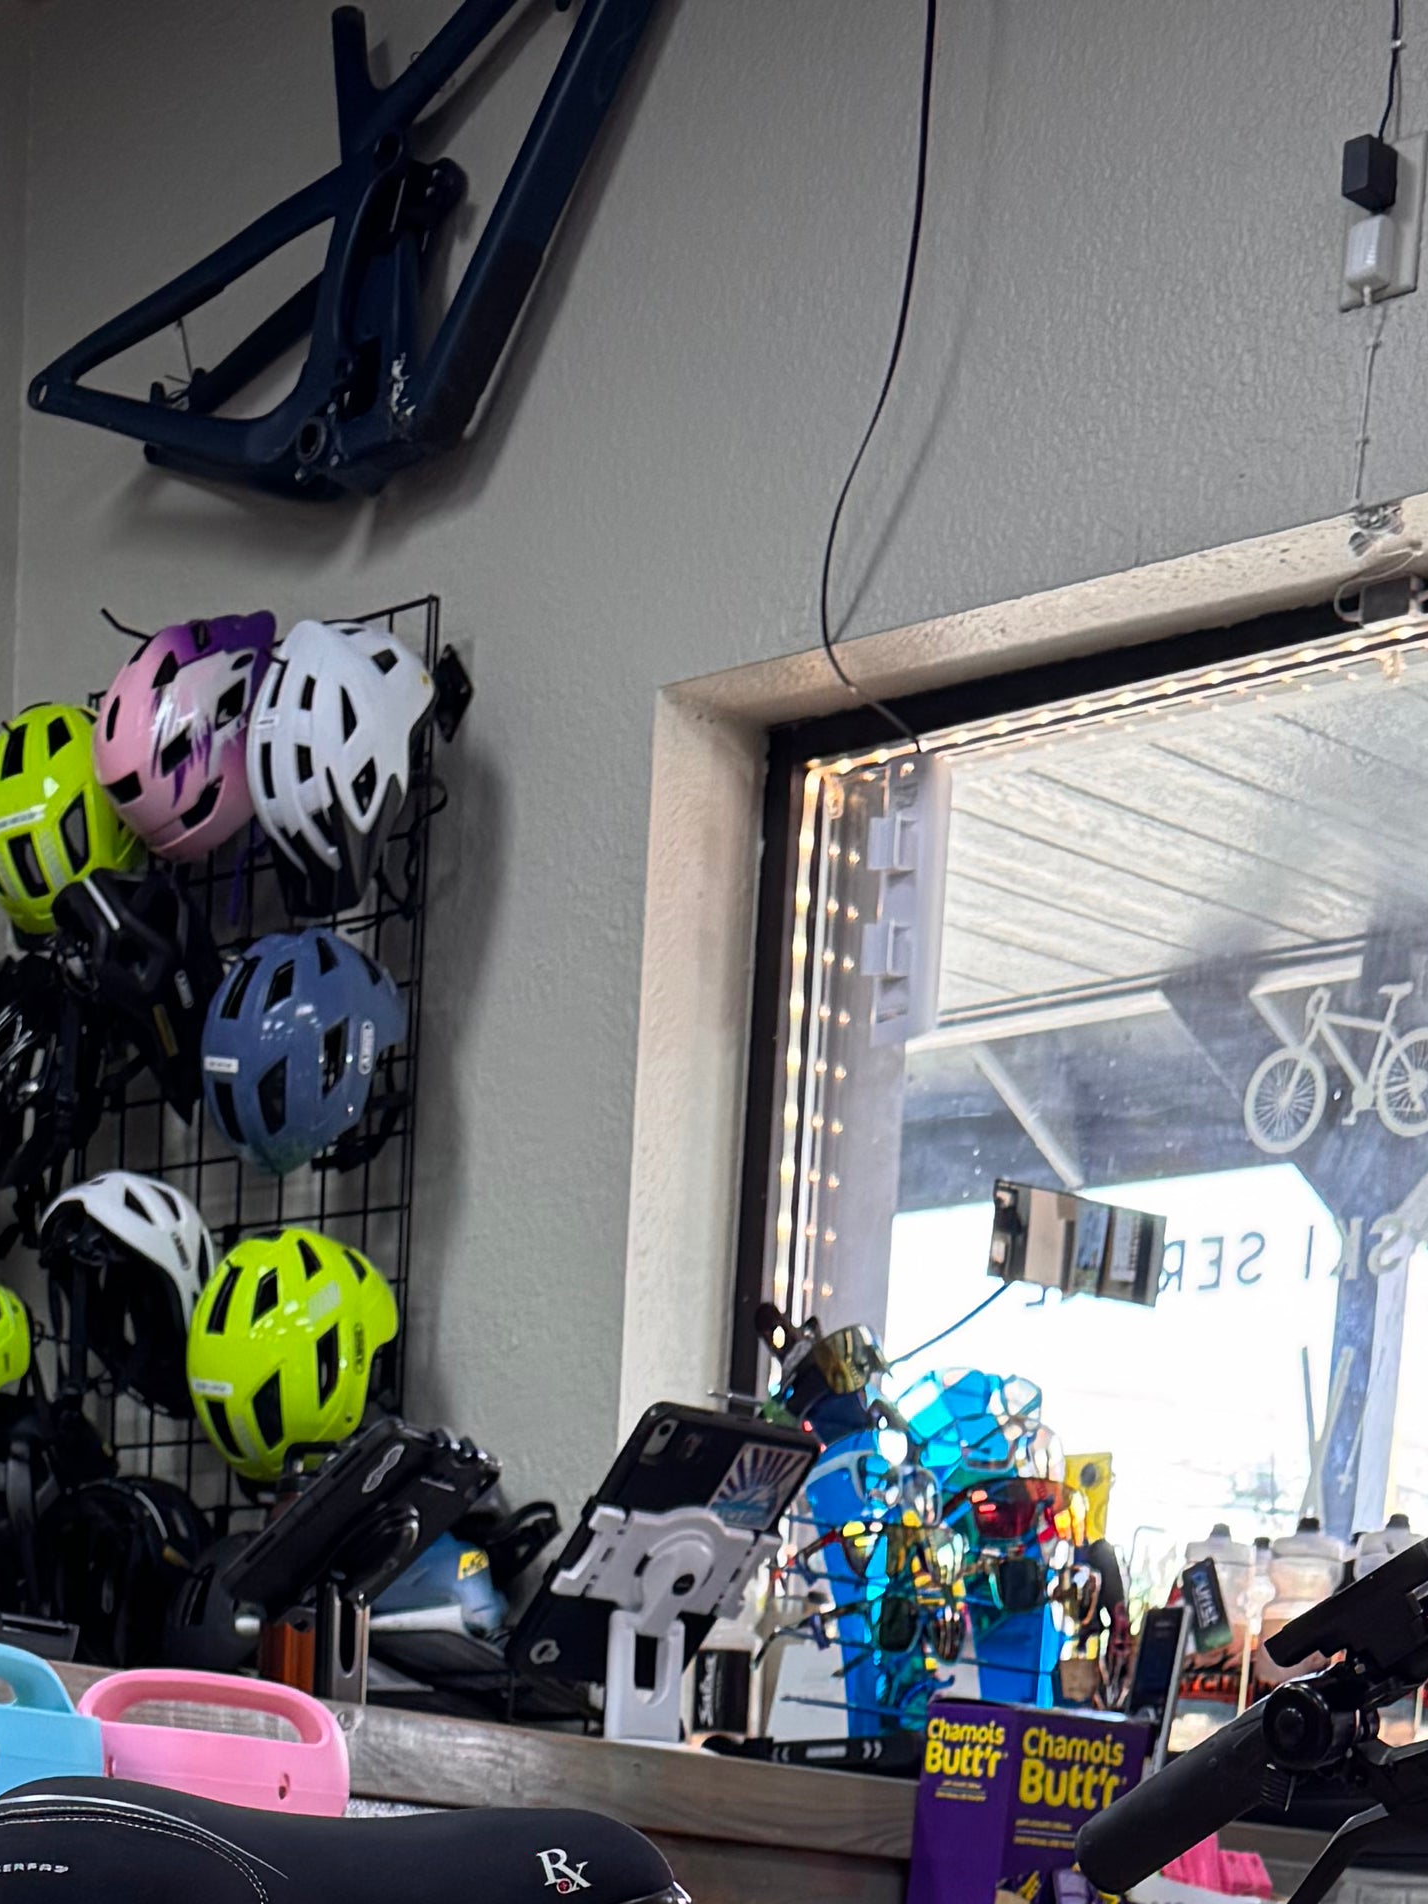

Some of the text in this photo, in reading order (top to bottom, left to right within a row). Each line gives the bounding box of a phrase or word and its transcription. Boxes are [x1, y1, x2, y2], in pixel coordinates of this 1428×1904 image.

[927, 1717, 1006, 1746] Chamois
[1021, 1726, 1126, 1768] Chamois
[924, 1738, 1004, 1780] Butt'r
[1018, 1757, 1120, 1812] Butt'r
